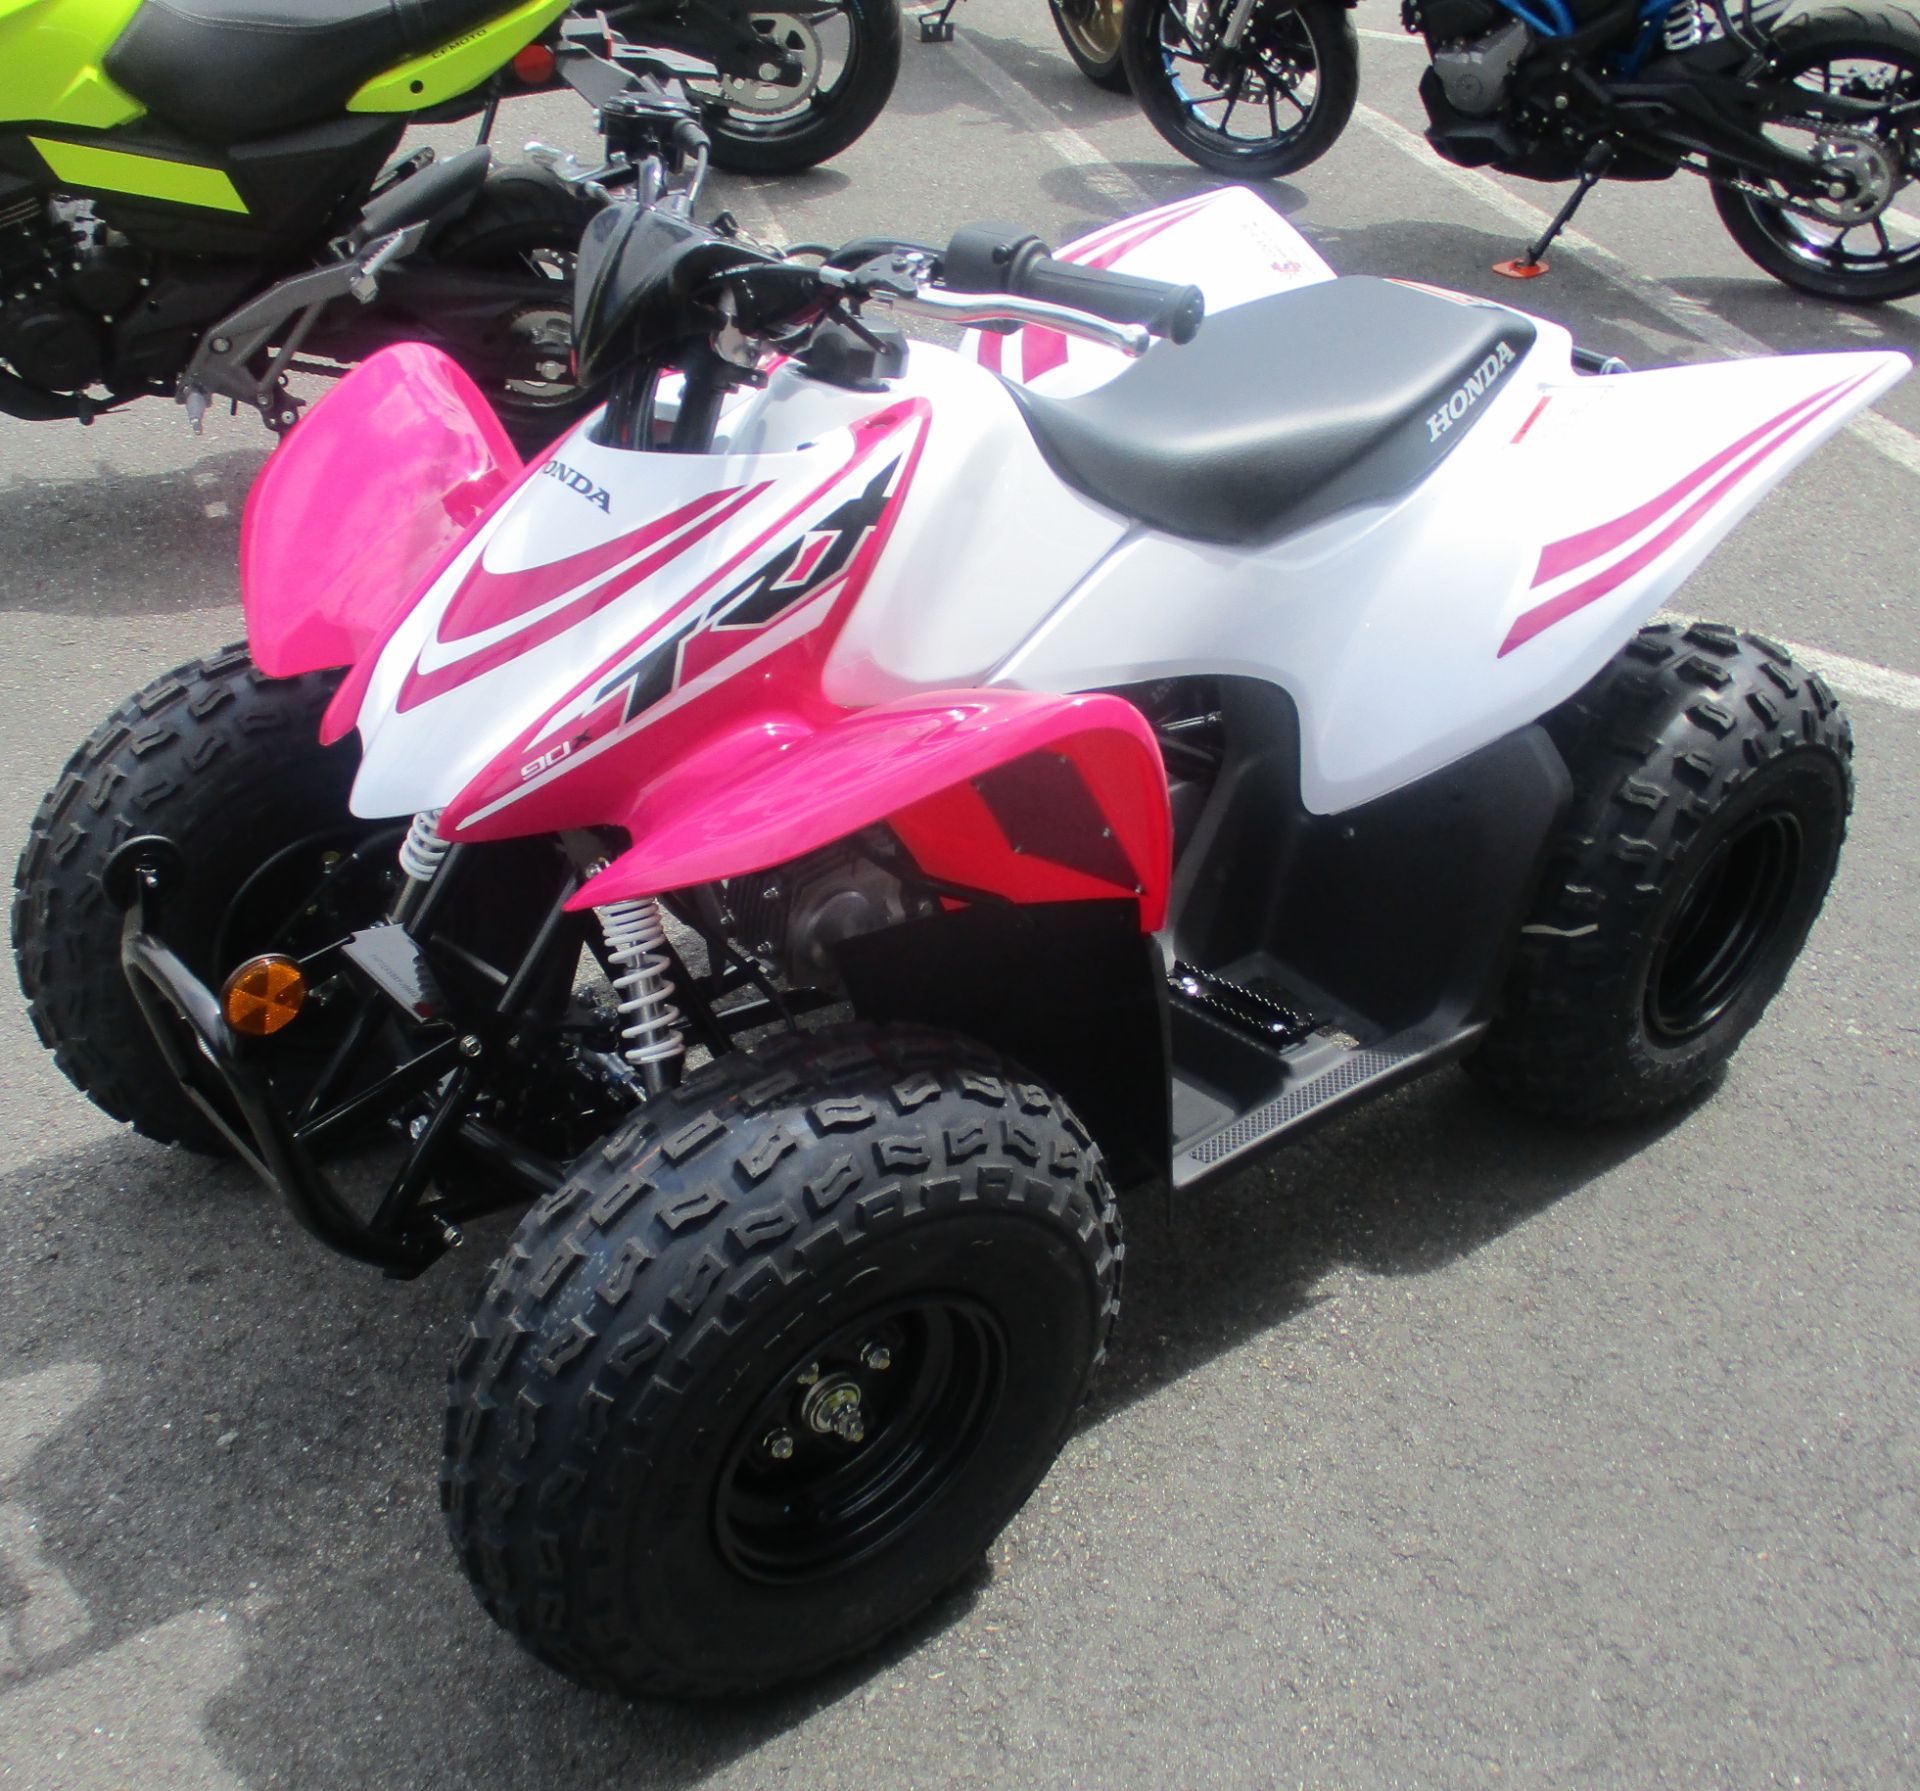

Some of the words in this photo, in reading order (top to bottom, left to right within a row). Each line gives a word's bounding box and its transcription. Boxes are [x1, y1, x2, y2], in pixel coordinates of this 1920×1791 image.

[1426, 341, 1516, 442] HONDA
[542, 459, 611, 515] ONDA
[592, 451, 904, 724] TRX
